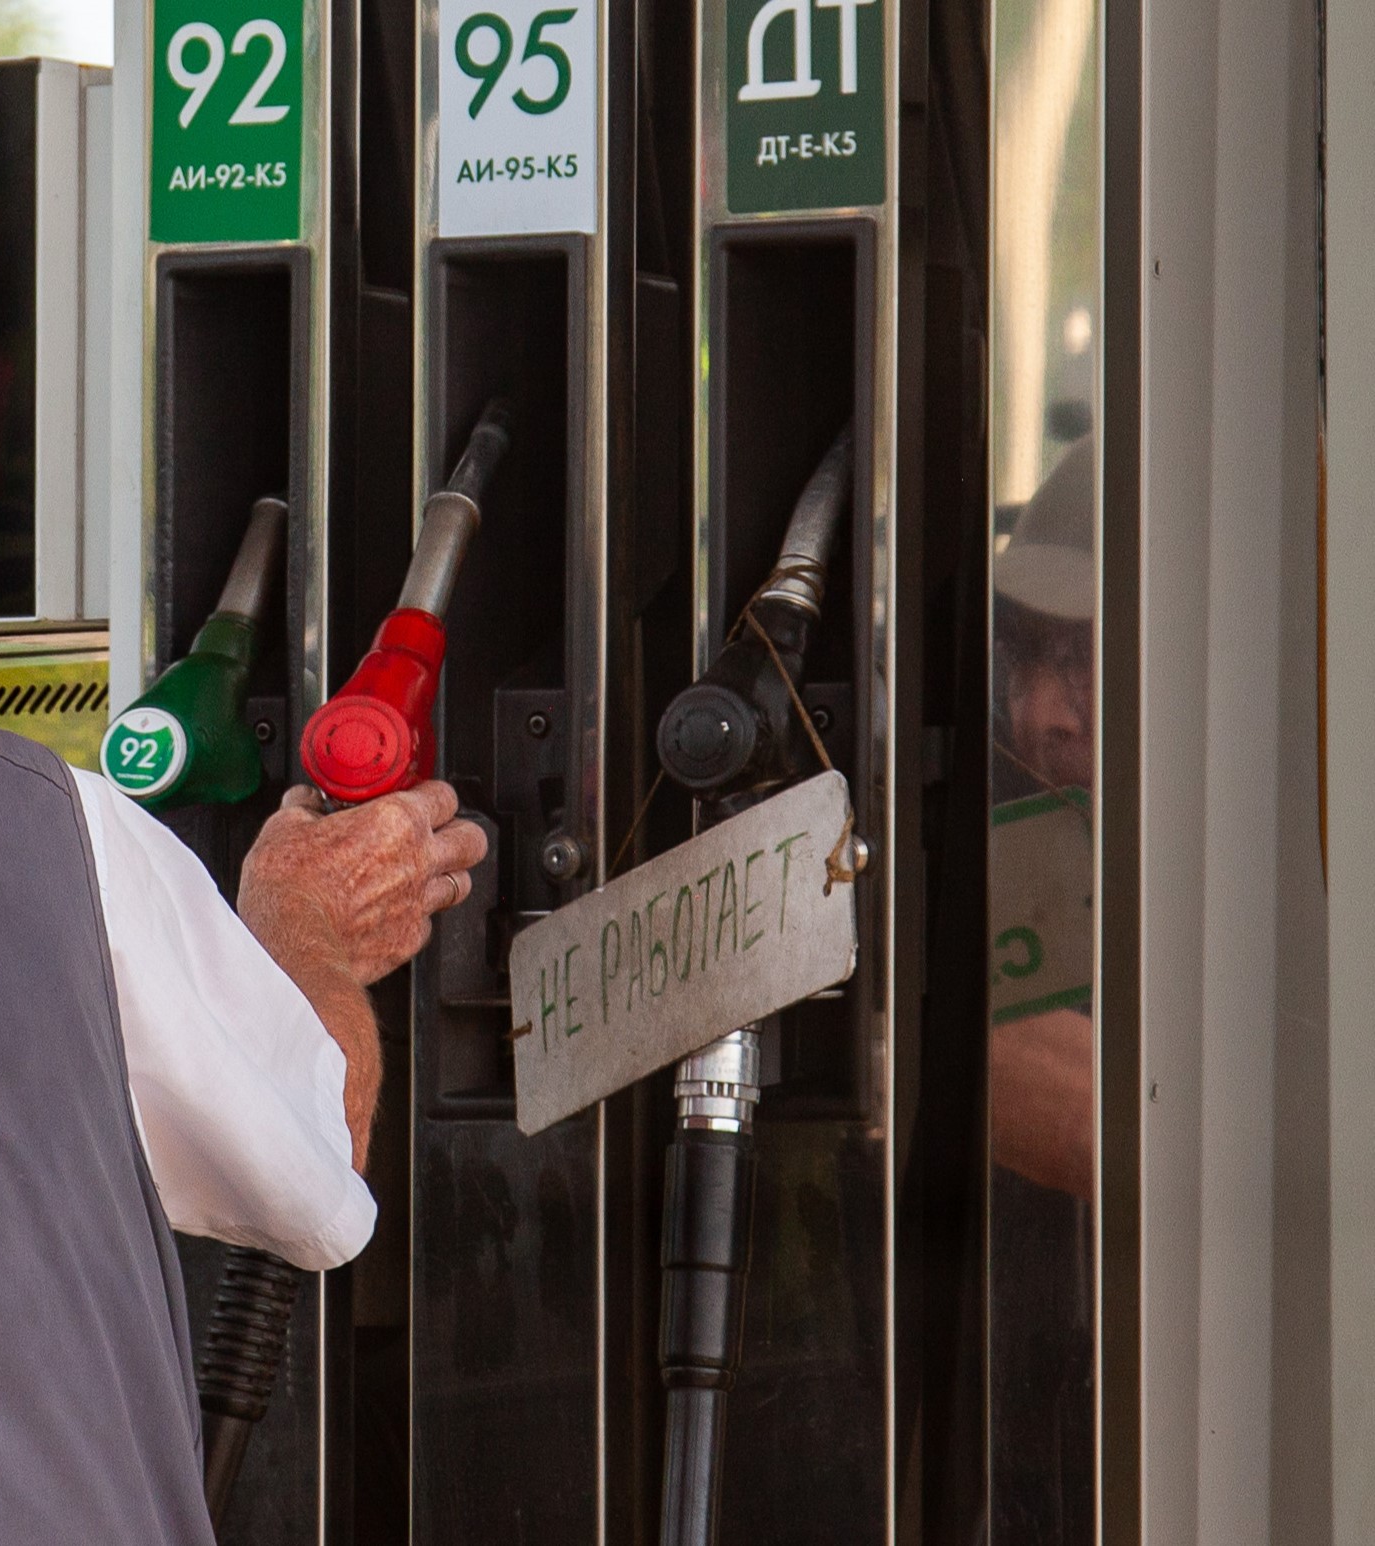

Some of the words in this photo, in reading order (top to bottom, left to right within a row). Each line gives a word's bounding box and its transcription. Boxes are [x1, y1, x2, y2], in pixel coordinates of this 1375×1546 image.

[167, 18, 291, 129] 92
[454, 7, 578, 120] 95
[738, 0, 876, 101] ДТ
[168, 162, 287, 191] АИ-92-К5
[456, 153, 578, 184] АИ-95-К5
[757, 130, 857, 166] ДТ-Е-К5
[120, 736, 158, 768] 92
[539, 943, 583, 1053] НЕ
[601, 830, 808, 1025] РАБОТАЕТ
